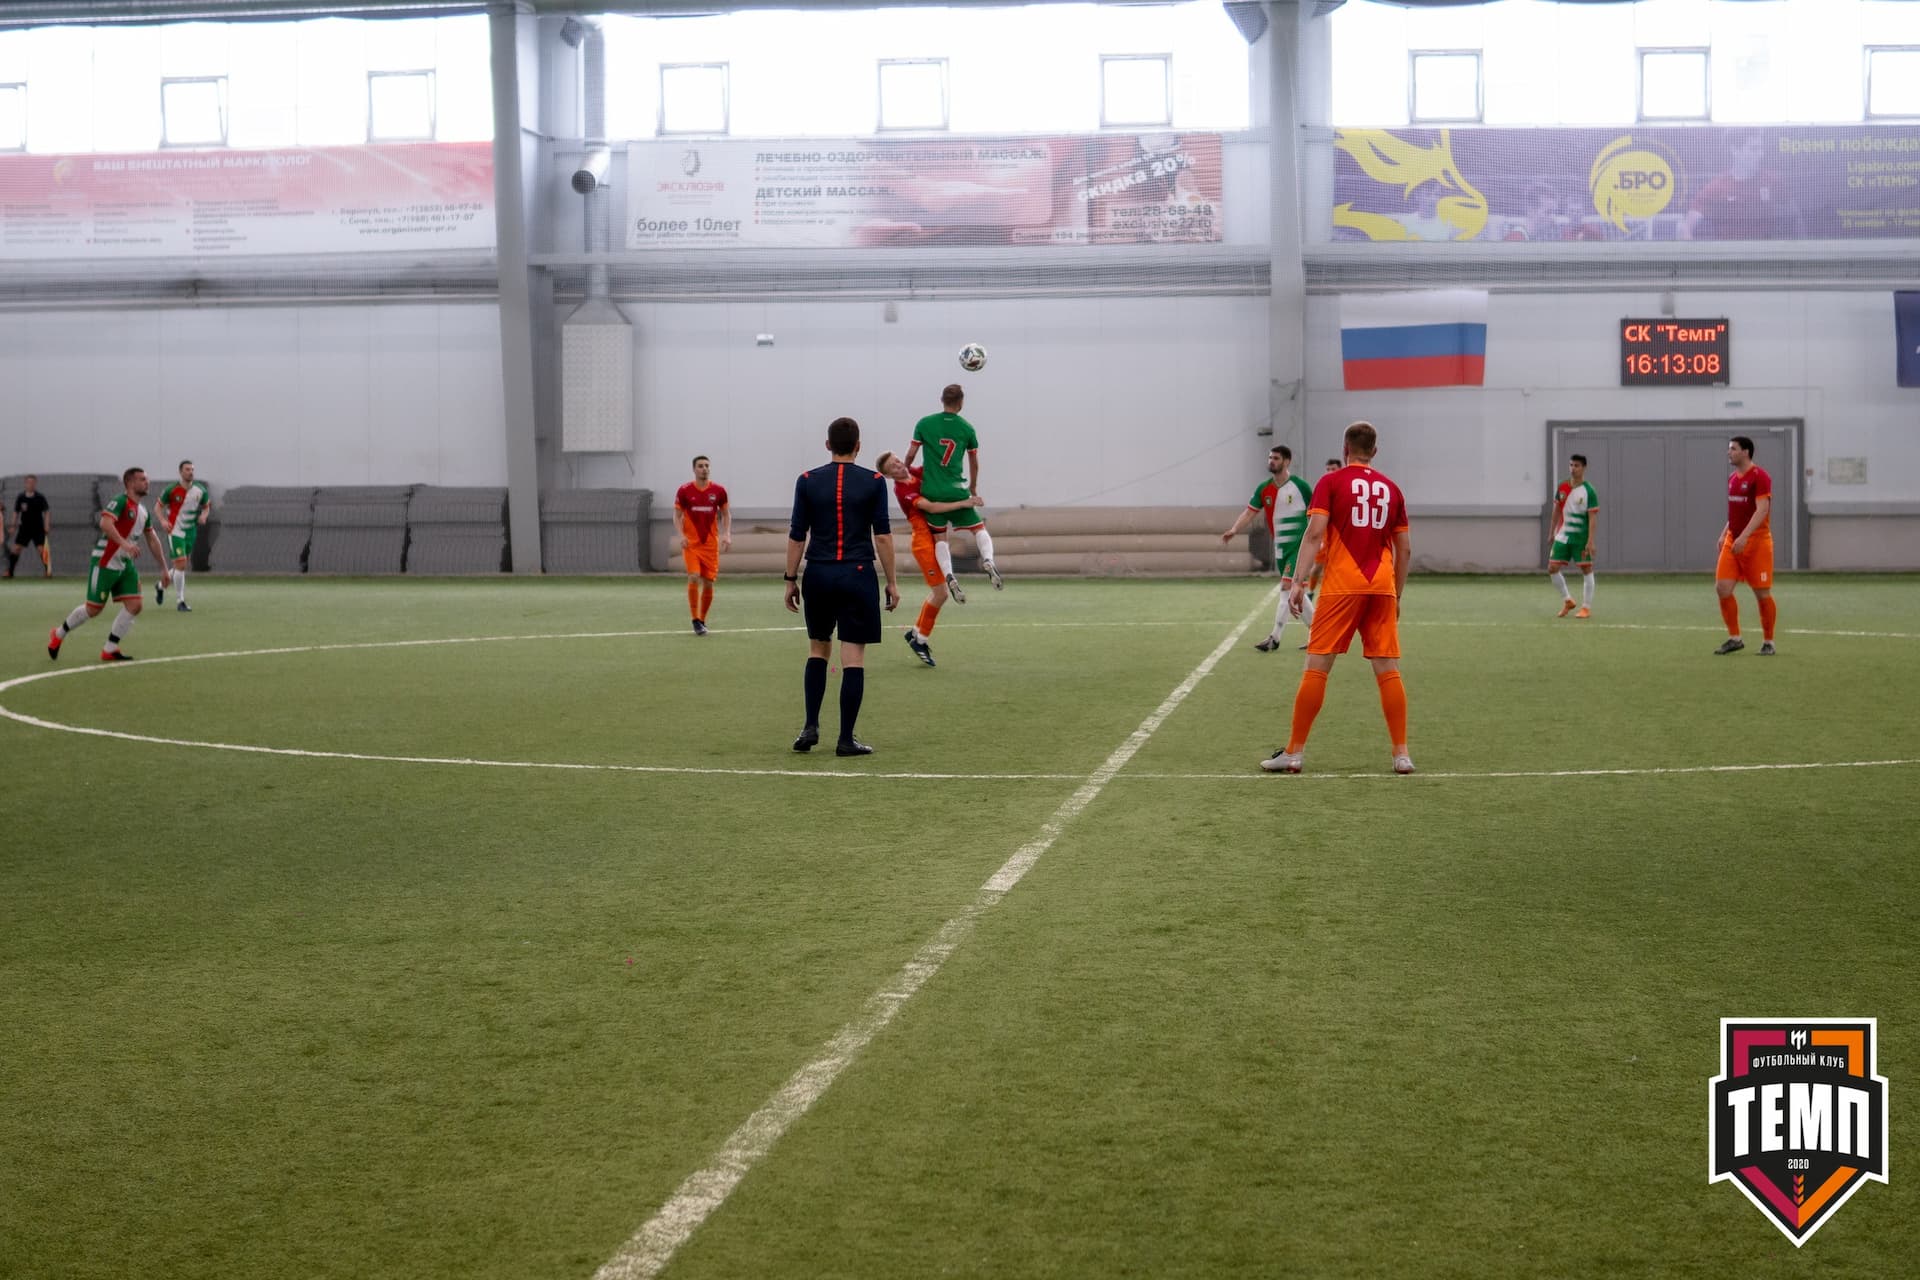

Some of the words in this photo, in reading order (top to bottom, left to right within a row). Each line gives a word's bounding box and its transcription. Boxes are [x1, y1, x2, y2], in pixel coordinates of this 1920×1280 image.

[1778, 137, 1836, 154] Время
[93, 159, 125, 171] ВАШ
[128, 156, 220, 171] ВНЕШТАТНЫЙ
[223, 154, 313, 169] МАРКЕТОЛОГ
[755, 149, 974, 163] ЛЕЧЕБНО-ОЗДОРОВИТЕЛЬНЫЙ
[978, 149, 1047, 161] МАССАЖ:
[1077, 170, 1148, 202] скидка
[1151, 151, 1197, 177] 20%
[1847, 176, 1865, 188] СК
[657, 182, 724, 192] ЭКСКЛЮЗИВ
[755, 184, 822, 199] ДЕТСКИЙ
[826, 185, 896, 198] МАССАЖ:
[637, 216, 688, 231] более
[694, 217, 742, 231] 10лет
[1625, 325, 1651, 342] СК
[1657, 324, 1726, 342] "Темп"
[1626, 354, 1721, 375] 16:13:08
[939, 438, 957, 467] 7
[1351, 478, 1391, 529] 33
